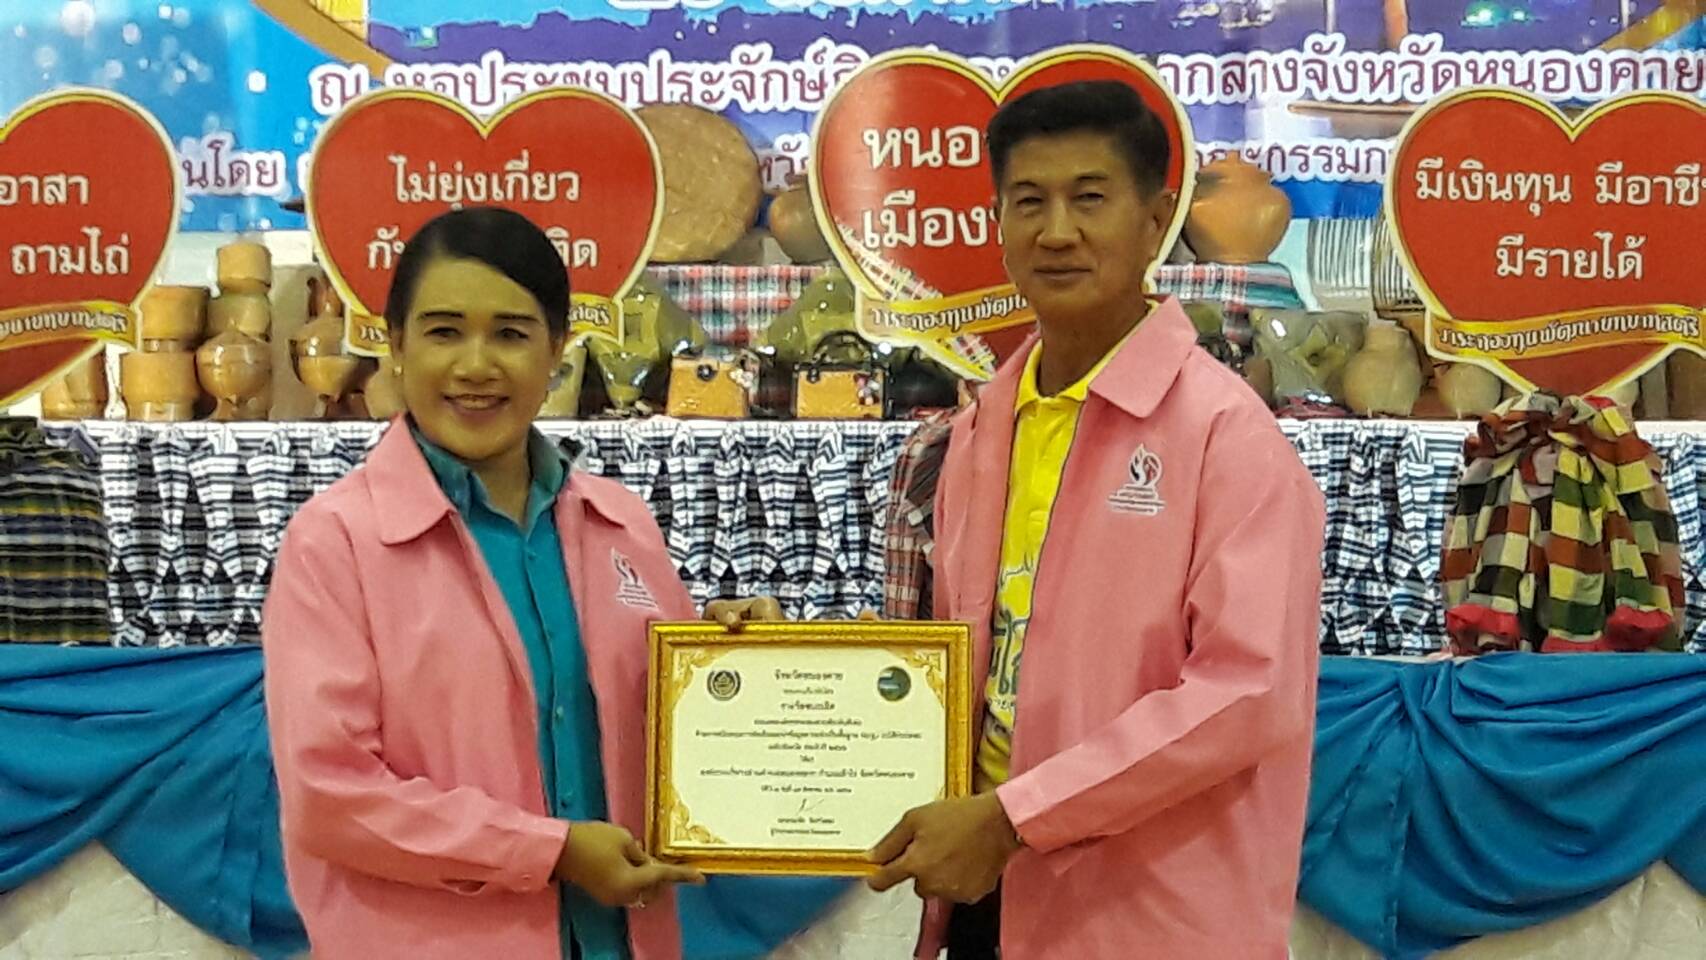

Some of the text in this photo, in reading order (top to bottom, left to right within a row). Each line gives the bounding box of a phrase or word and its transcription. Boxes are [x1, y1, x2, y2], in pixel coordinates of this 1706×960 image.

[388, 149, 580, 211] ไม่ยุ่งเกี่ยว
[1415, 156, 1706, 218] มีเงินทุน มีอาชี
[11, 226, 130, 275] ถามไถ่
[1495, 231, 1647, 280] มีรายได้
